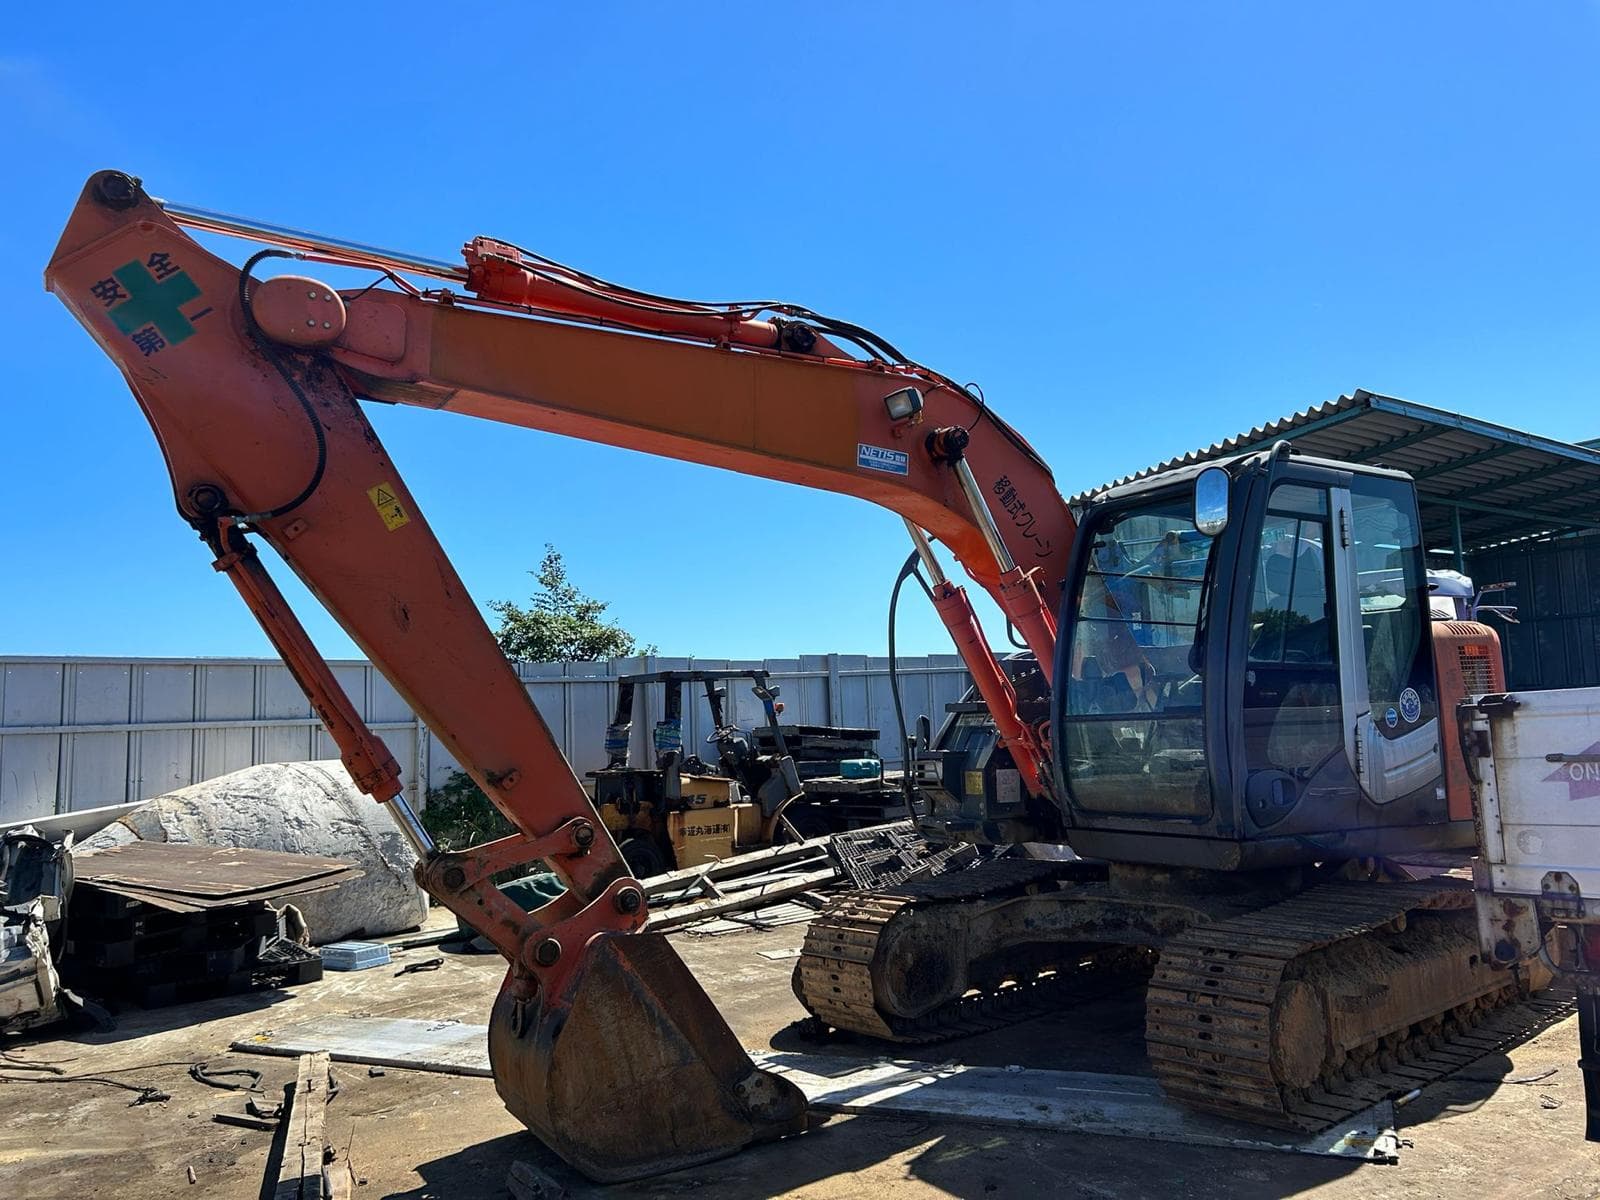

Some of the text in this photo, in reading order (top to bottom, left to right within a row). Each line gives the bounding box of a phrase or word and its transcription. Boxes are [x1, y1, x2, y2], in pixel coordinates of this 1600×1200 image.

[861, 446, 895, 460] NETIS
[992, 475, 1054, 558] 移動式クレーン
